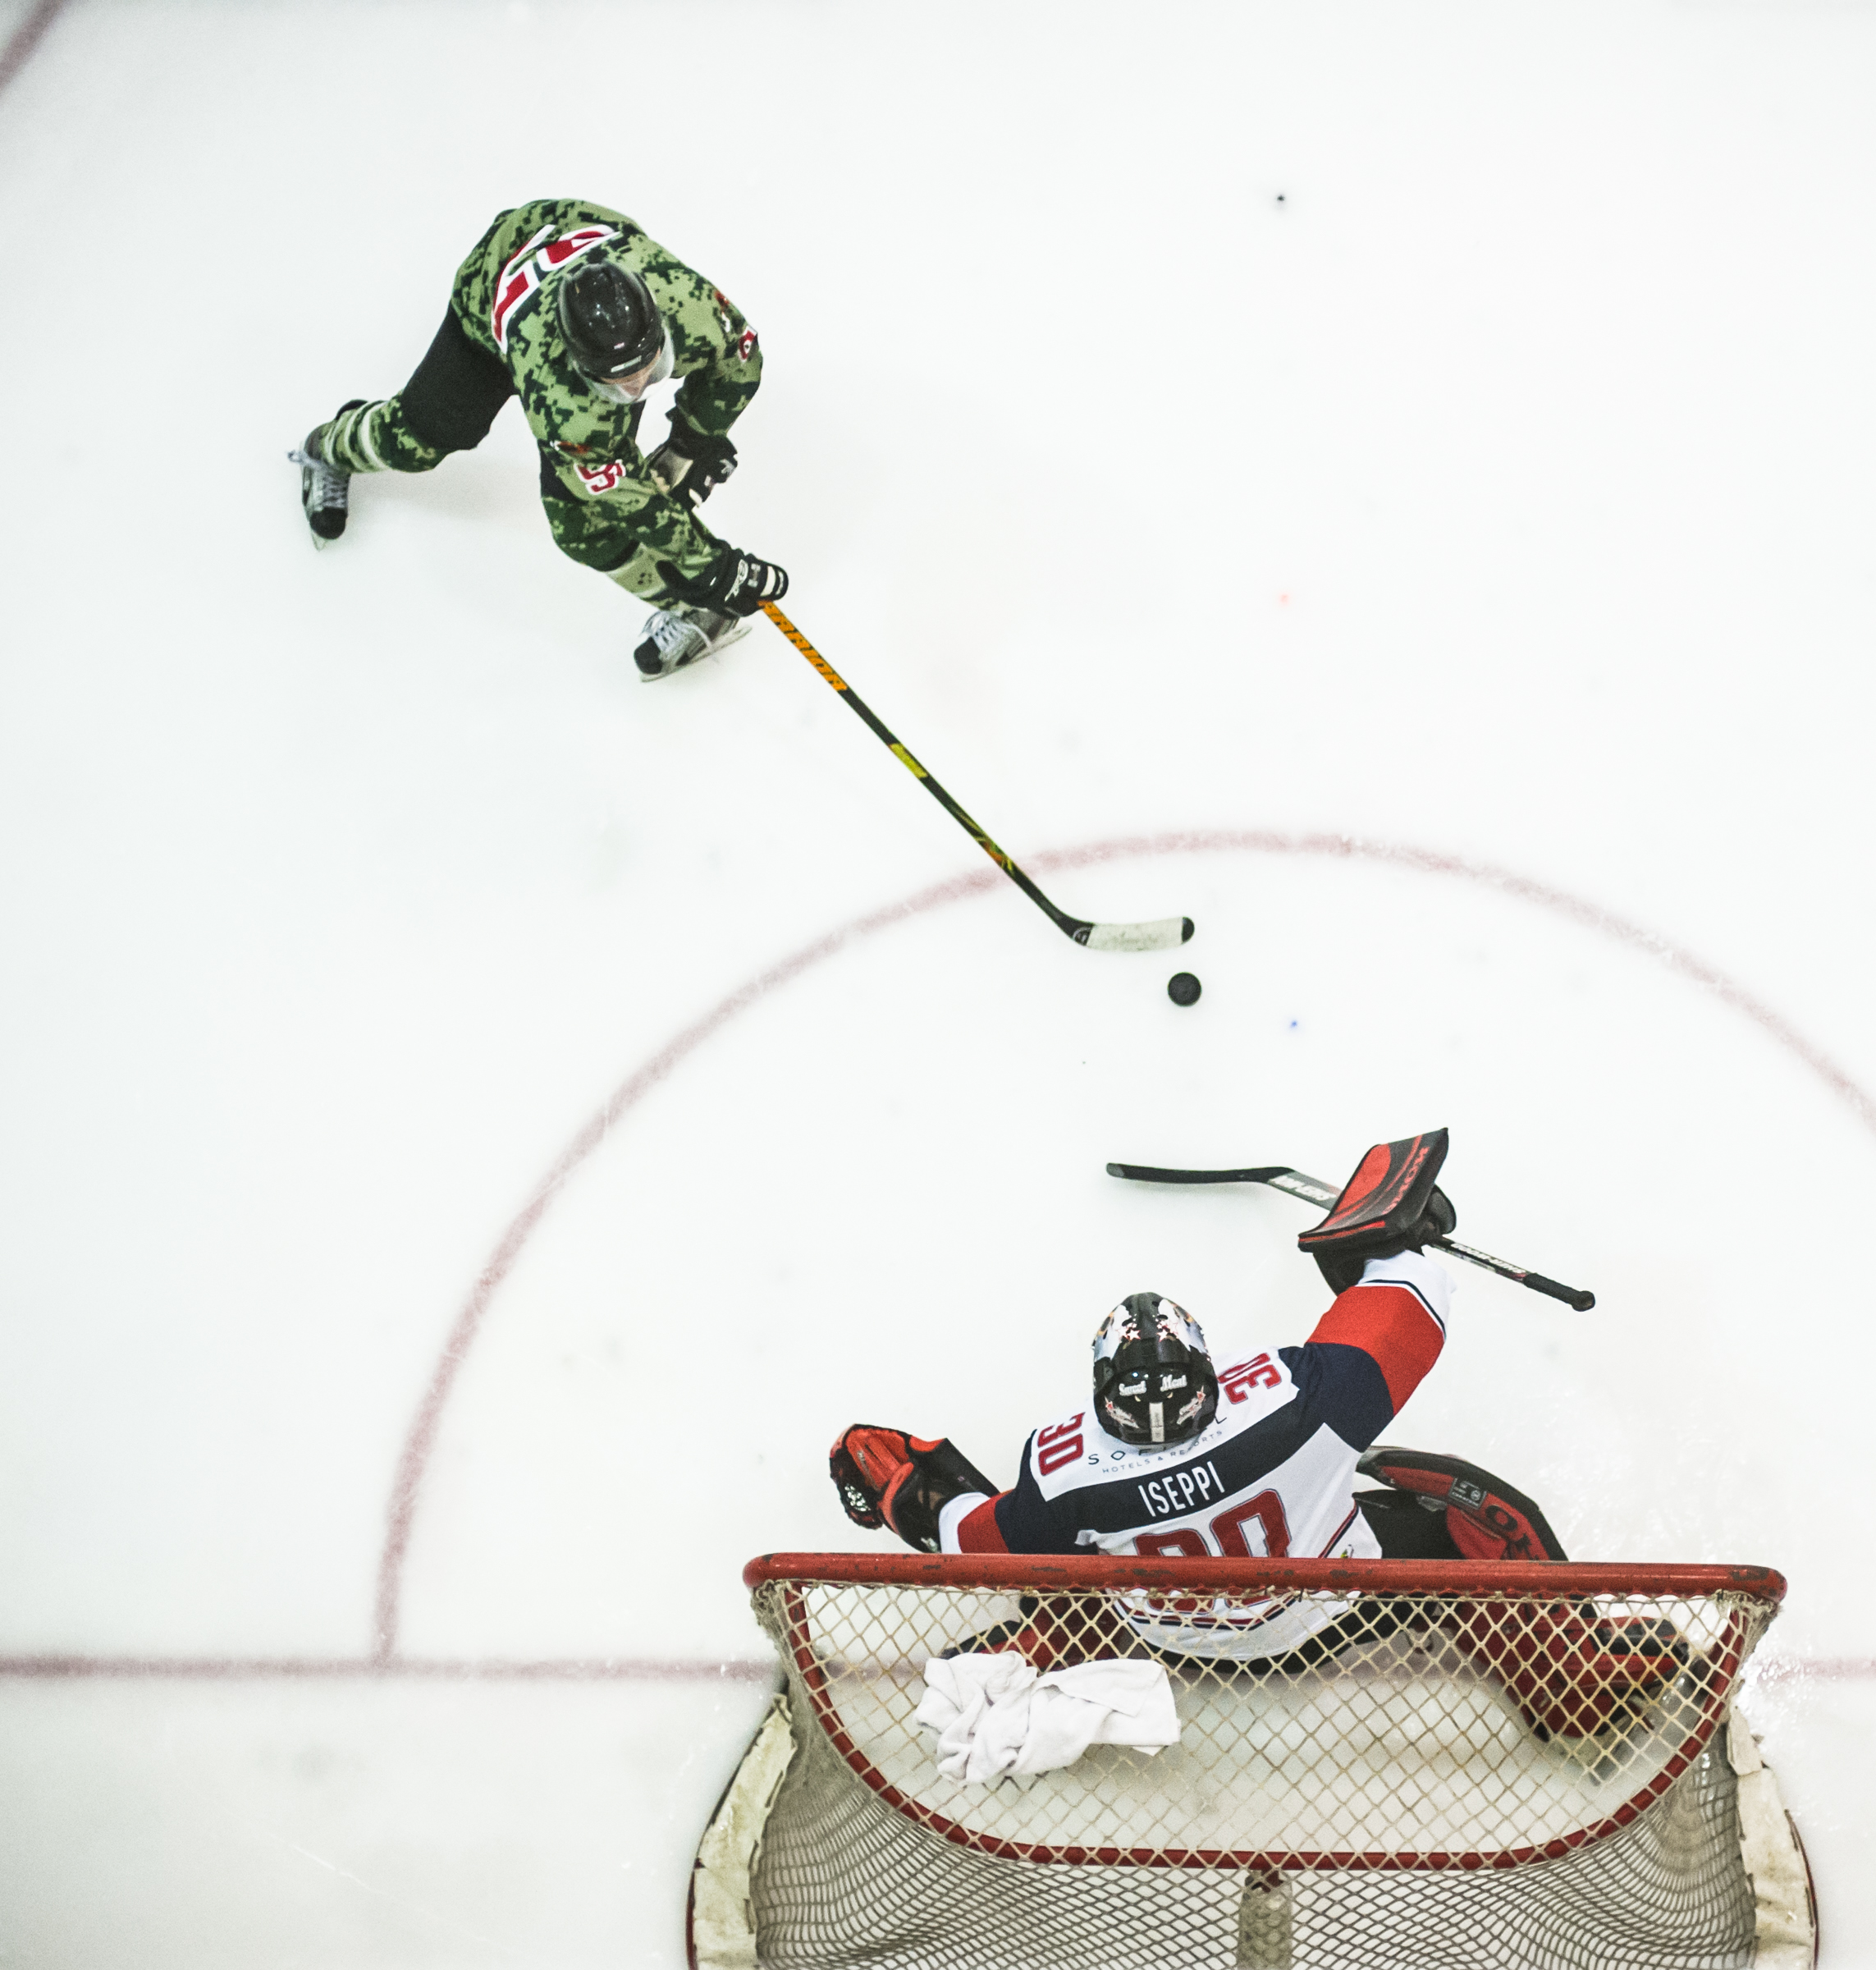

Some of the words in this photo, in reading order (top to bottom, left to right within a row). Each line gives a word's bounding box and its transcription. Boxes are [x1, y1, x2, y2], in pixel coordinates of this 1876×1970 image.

[1216, 1352, 1282, 1405] 30
[1036, 1411, 1086, 1478] 30
[1101, 1457, 1151, 1474] HOTELS
[1169, 1430, 1223, 1456] REORTS
[1137, 1459, 1226, 1518] ISEPPI
